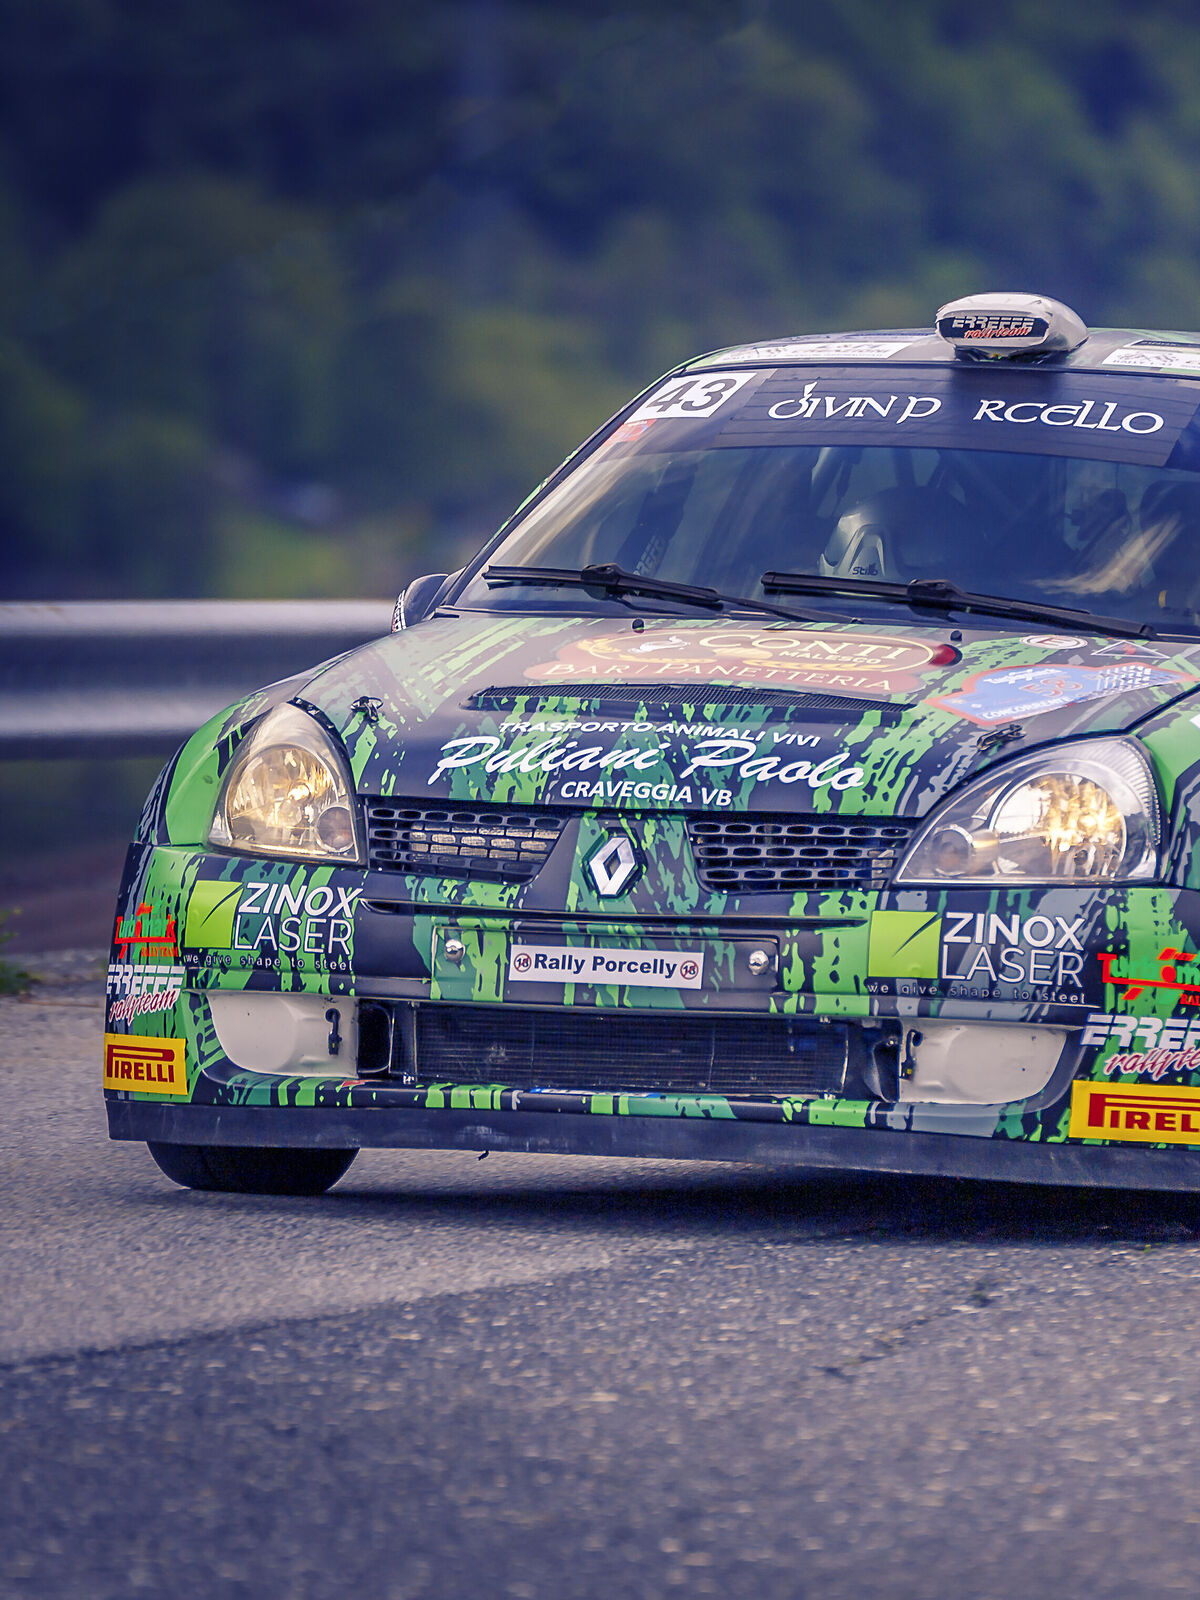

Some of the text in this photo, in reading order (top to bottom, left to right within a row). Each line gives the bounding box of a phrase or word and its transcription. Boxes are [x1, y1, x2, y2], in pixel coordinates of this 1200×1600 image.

[952, 316, 1035, 331] ERREFFE
[645, 378, 738, 413] 43
[973, 399, 1164, 435] RCELLO
[699, 634, 913, 661] CONTI
[780, 650, 883, 665] MALESCO
[659, 663, 892, 691] PANETTERIA
[498, 721, 822, 748] TRASPORTO ANIMALI VIVI
[427, 734, 867, 791] Puliani Paolo
[560, 780, 733, 807] CRAVEGGIA VB
[237, 881, 364, 918] ZINOX
[233, 914, 353, 956] LASER
[942, 911, 1086, 951] ZINOX
[185, 953, 354, 971] we give shape to steel
[533, 952, 586, 975] Rally
[591, 955, 678, 980] Porcelly
[941, 944, 1085, 988] LASER
[867, 982, 1086, 1005] we give shape to steel
[106, 1044, 176, 1084] PIRELLI
